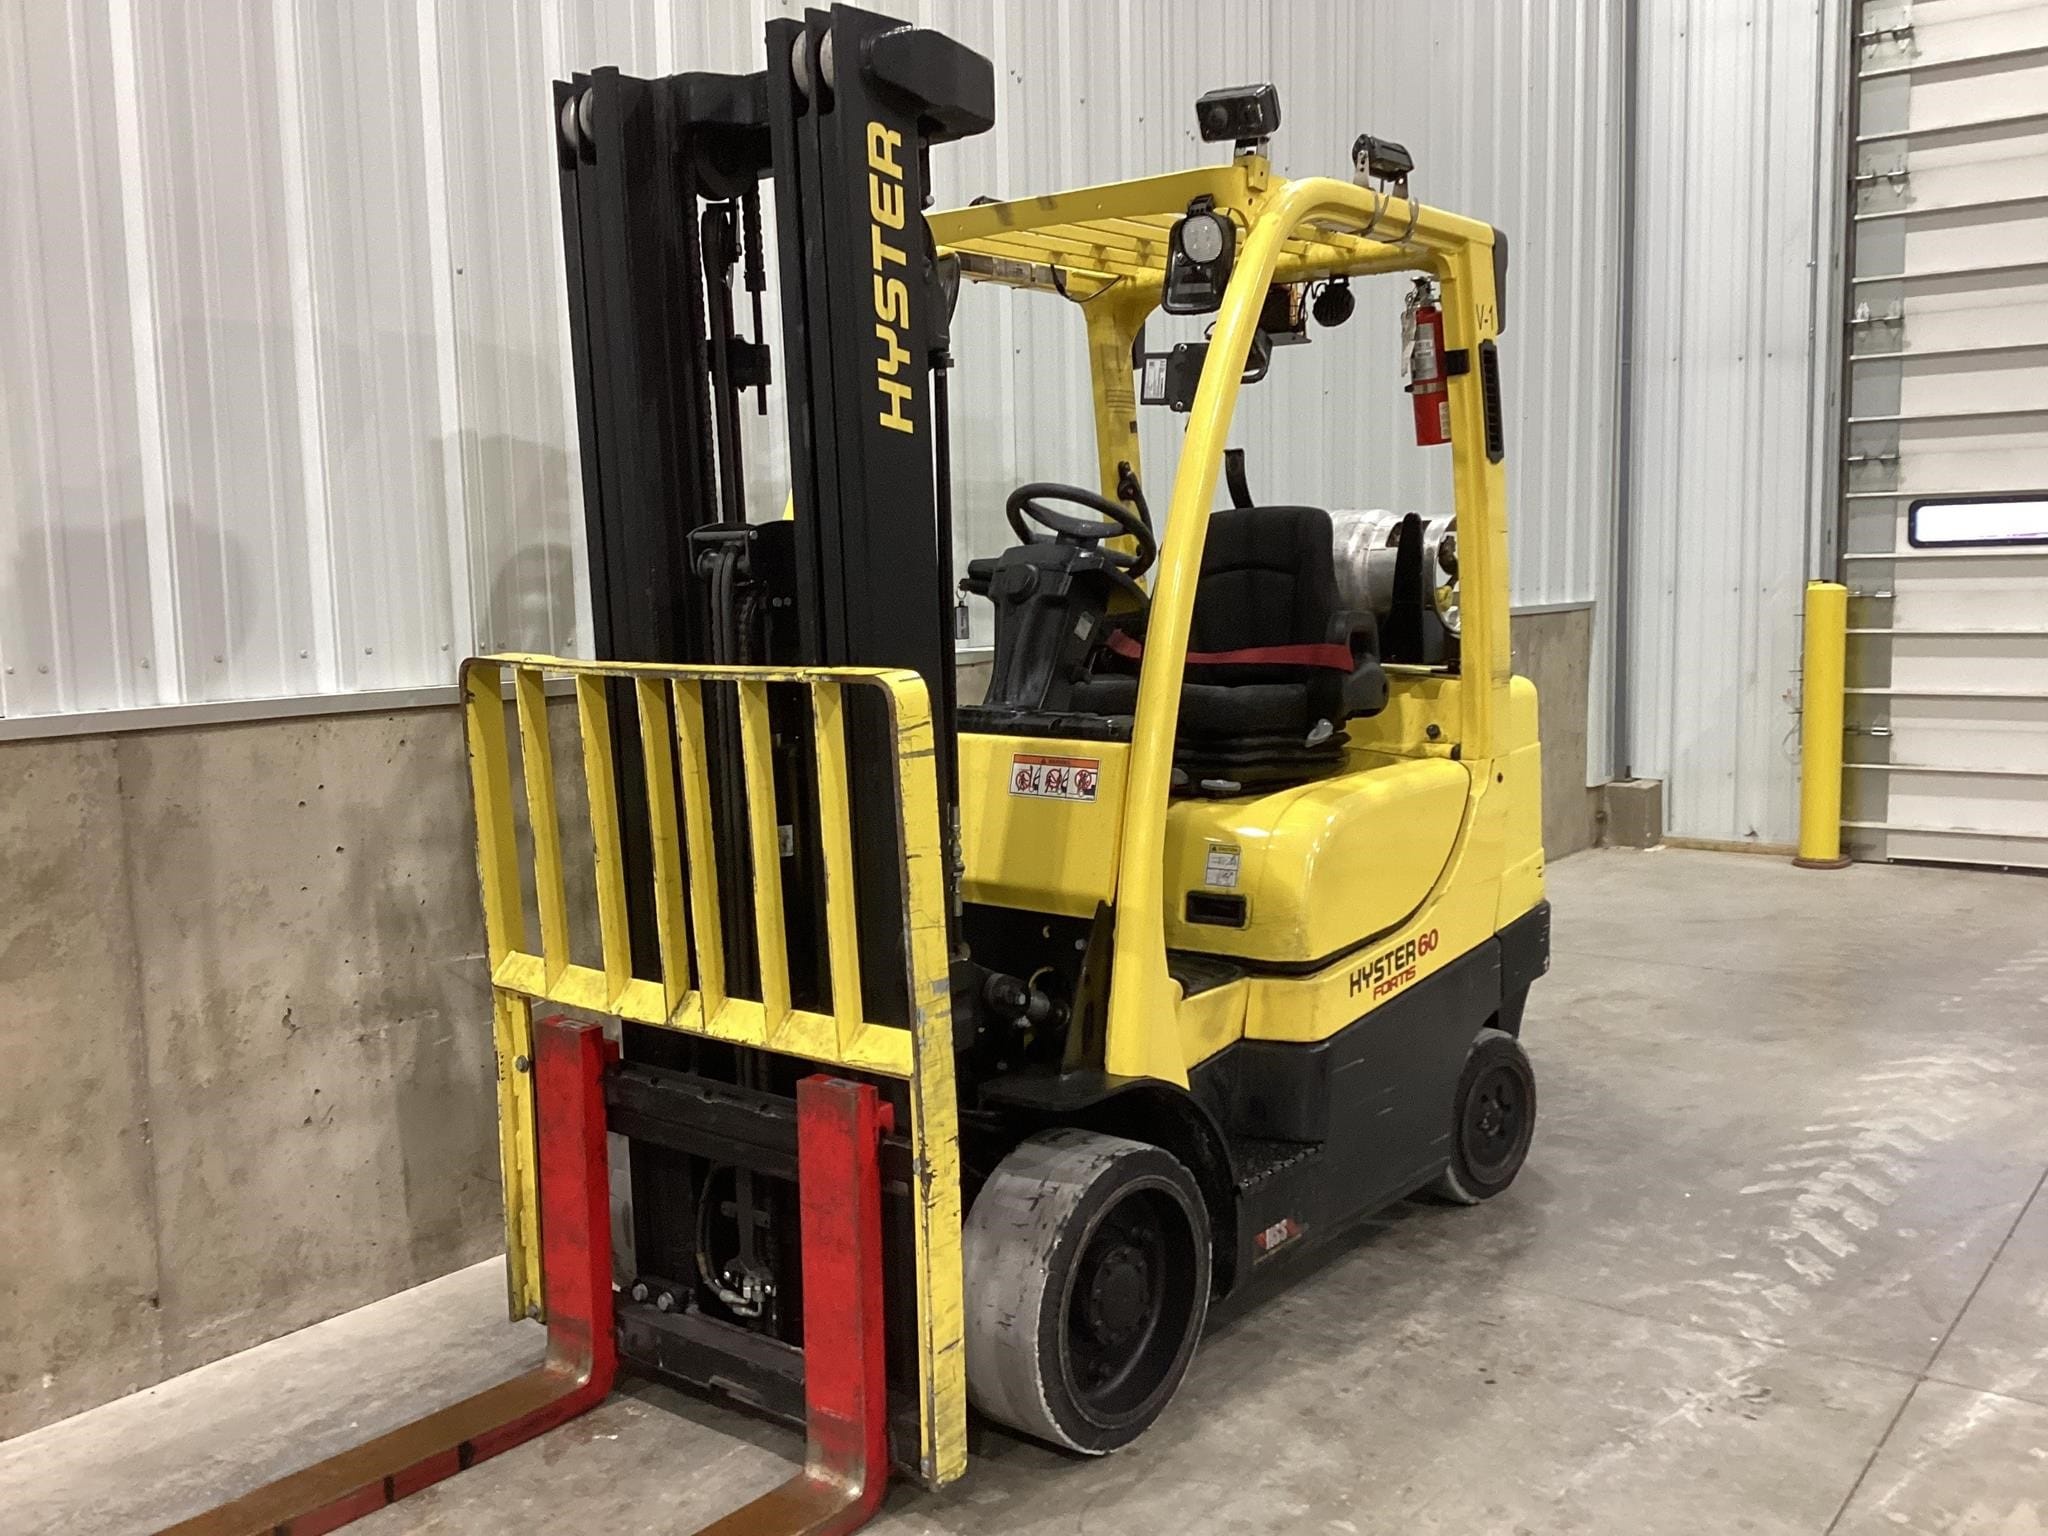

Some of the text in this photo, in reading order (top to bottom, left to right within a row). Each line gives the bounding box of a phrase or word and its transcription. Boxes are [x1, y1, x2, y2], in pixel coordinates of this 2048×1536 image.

[867, 121, 914, 434] HYSTER
[1350, 928, 1438, 998] HYSTER 60
[1373, 965, 1416, 1000] FORTIS
